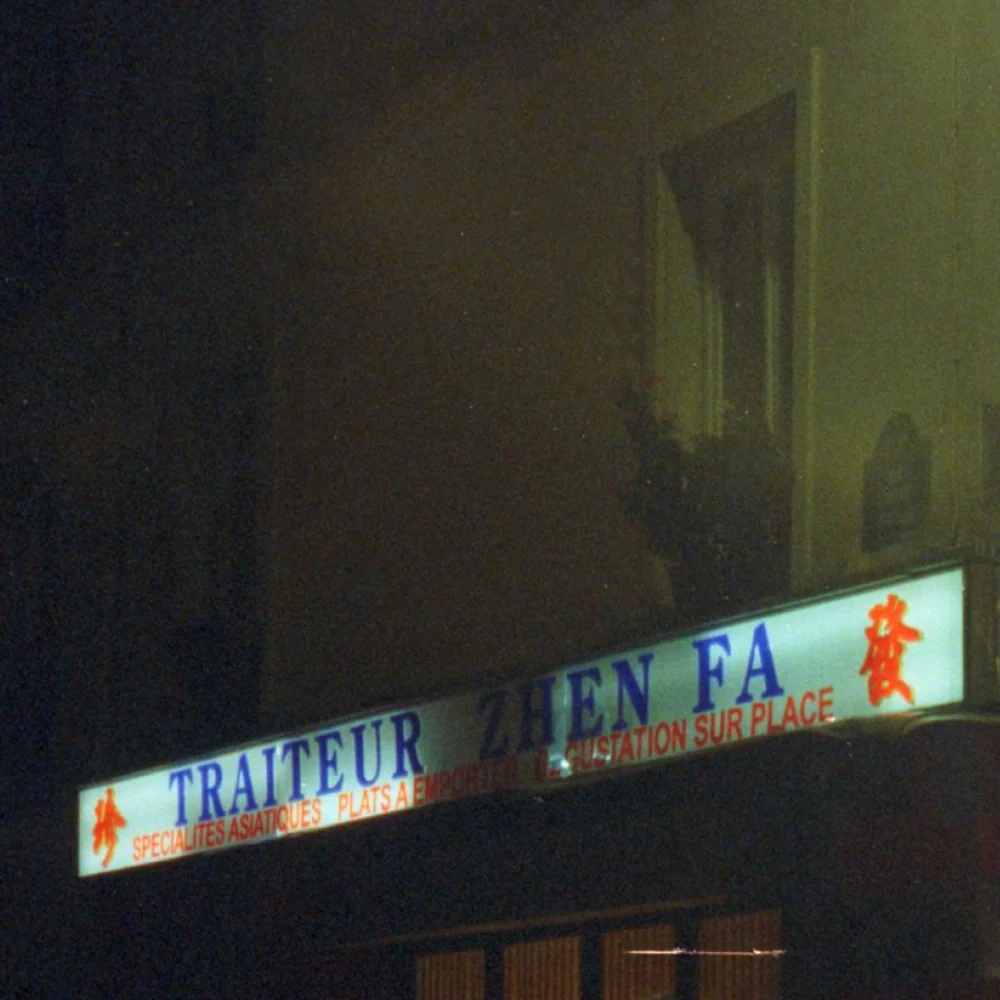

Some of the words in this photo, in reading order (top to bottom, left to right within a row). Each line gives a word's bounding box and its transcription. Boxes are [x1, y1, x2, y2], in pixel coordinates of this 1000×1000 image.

[132, 820, 226, 862] SPECIALITES
[227, 799, 322, 843] ASIATIQUES
[337, 786, 393, 823] PLATS
[395, 778, 410, 808] A
[536, 721, 687, 781] DGUSTATION
[694, 709, 743, 747] SUR
[750, 686, 835, 738] PLACE
[168, 711, 427, 828] TRAITEUR
[477, 653, 655, 760] ZHEN
[692, 621, 785, 714] FA
